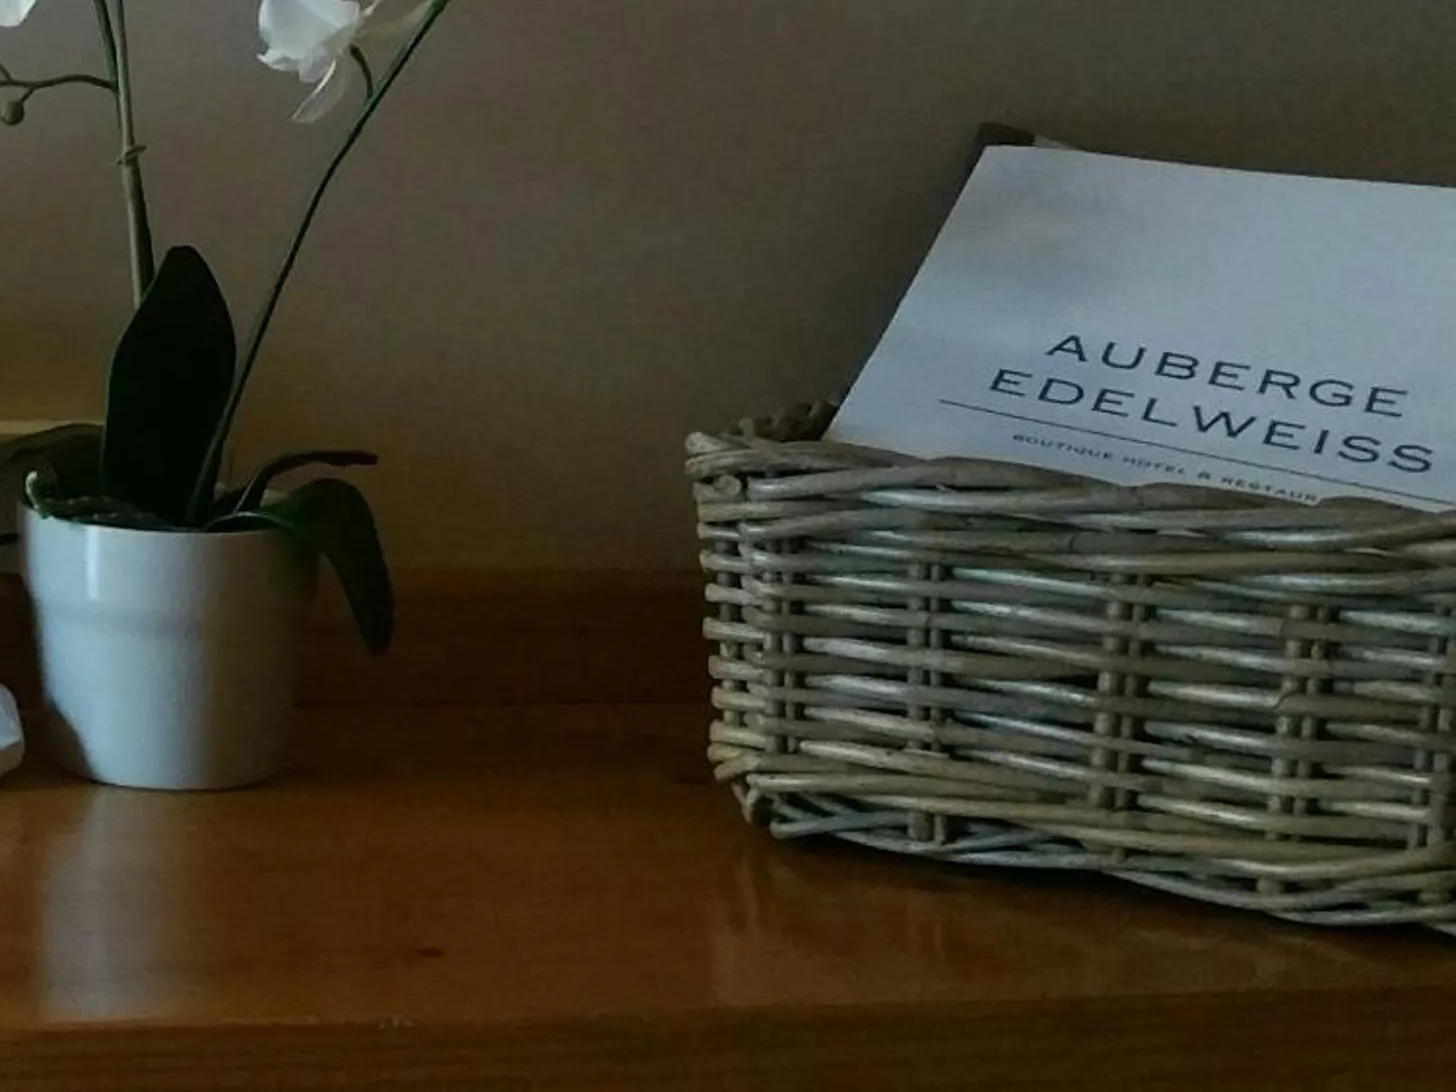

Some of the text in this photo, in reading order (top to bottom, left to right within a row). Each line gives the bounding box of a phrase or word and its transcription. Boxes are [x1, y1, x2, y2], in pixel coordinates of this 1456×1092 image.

[1046, 334, 1408, 417] AUBERGE
[989, 368, 1434, 473] EDELWEISS
[1013, 434, 1114, 459] BOUTIQUE
[1220, 476, 1318, 502] RESTAUR
